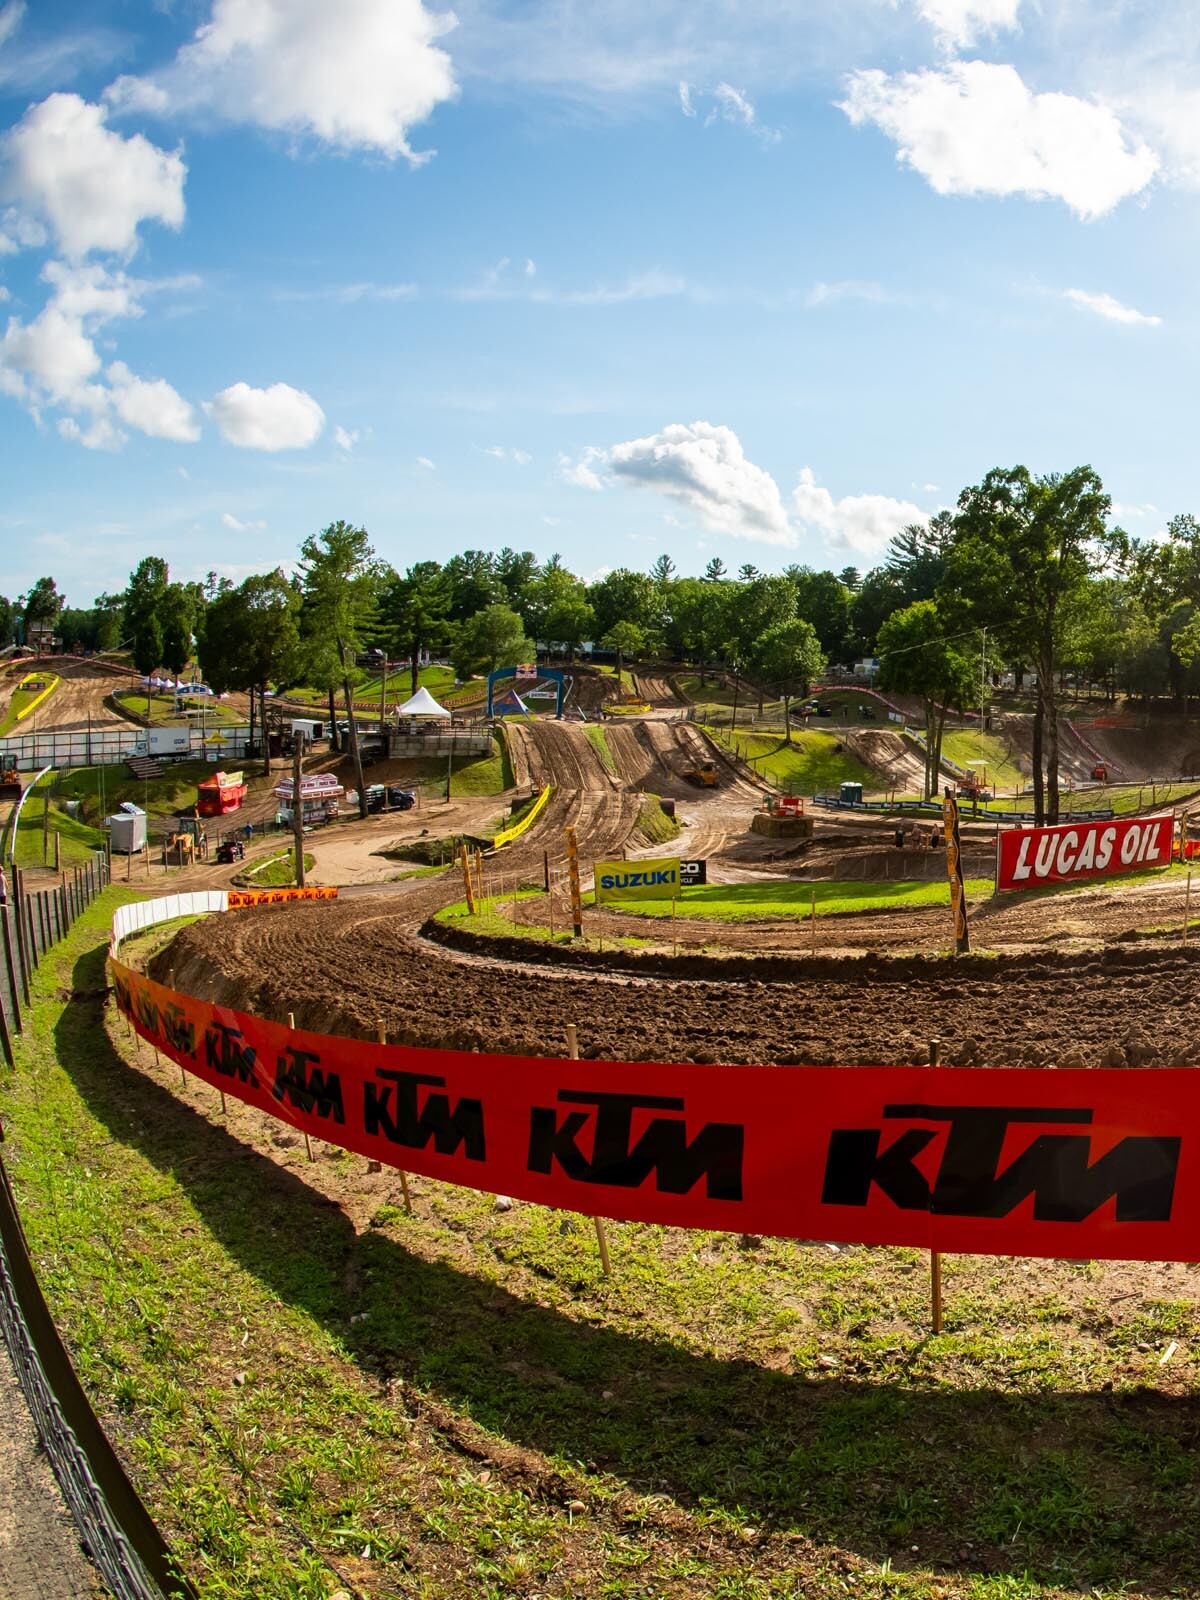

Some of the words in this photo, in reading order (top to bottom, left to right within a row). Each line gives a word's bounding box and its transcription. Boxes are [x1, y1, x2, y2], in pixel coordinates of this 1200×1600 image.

[601, 870, 676, 889] SUZUKI
[1012, 827, 1116, 881] LUCAS
[1120, 823, 1160, 865] OIL
[205, 1021, 260, 1089] KTM
[273, 1046, 346, 1126] KTM
[364, 1068, 486, 1162] KTM
[527, 1089, 744, 1201] KTM
[821, 1104, 1182, 1222] KTM
